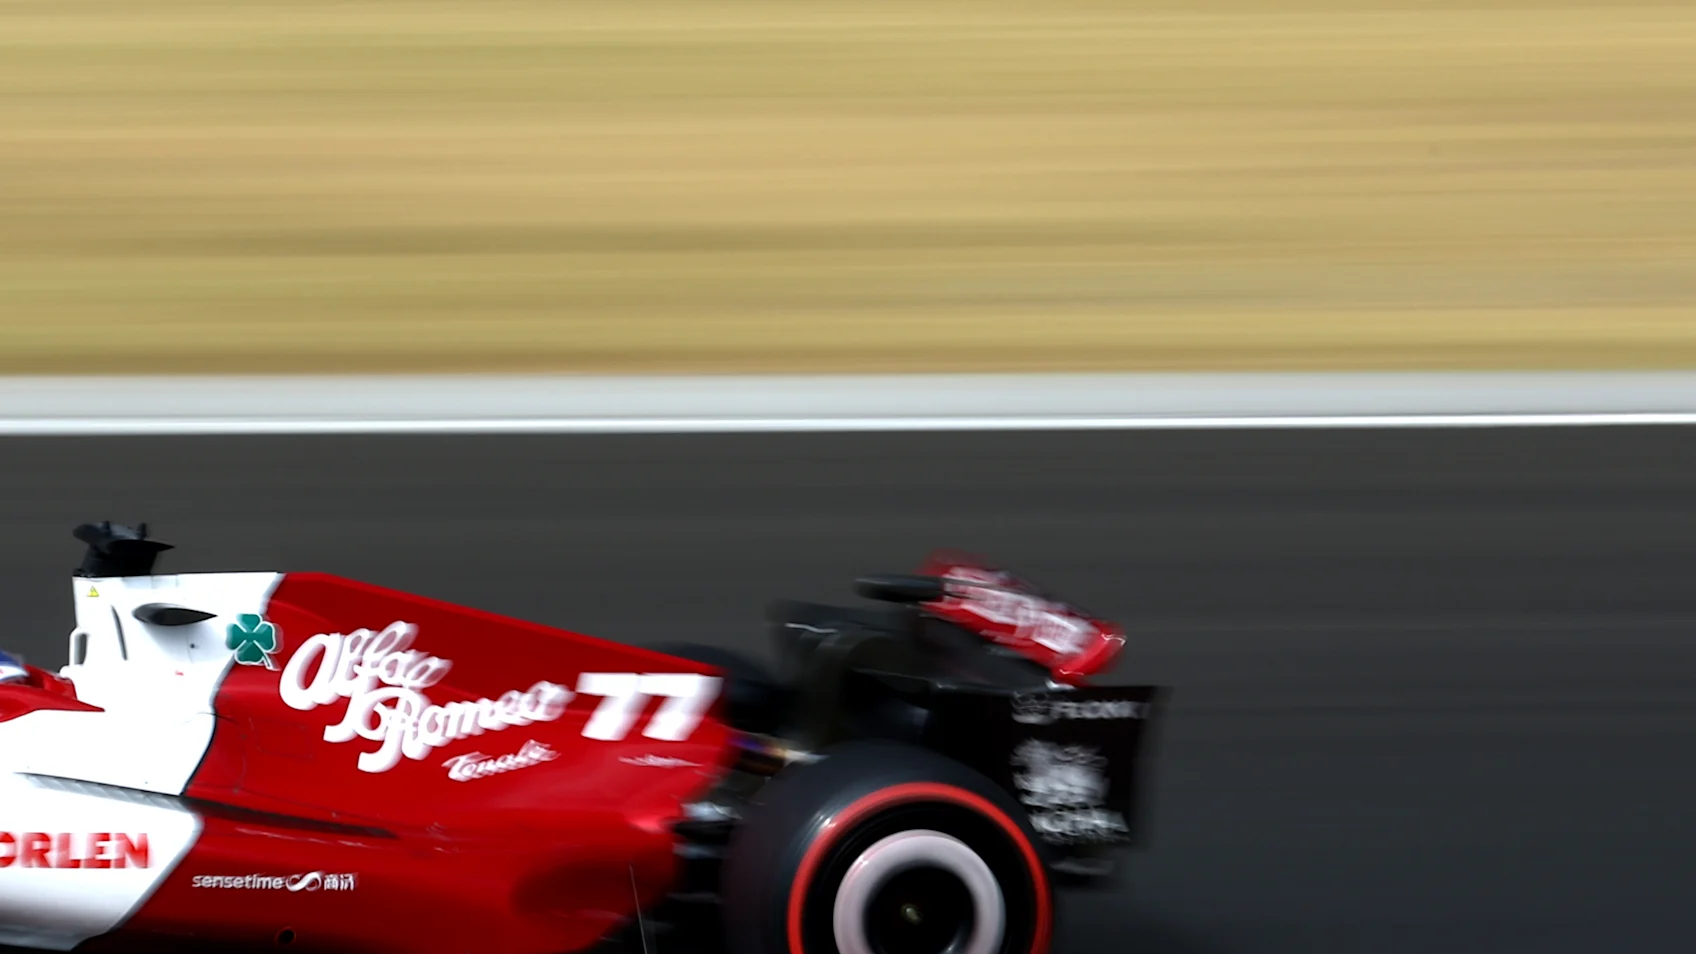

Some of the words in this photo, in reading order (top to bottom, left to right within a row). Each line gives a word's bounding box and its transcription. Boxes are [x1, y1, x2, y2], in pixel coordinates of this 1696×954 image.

[279, 621, 452, 710] Alfa
[323, 680, 577, 773] Romeo
[576, 672, 724, 741] 77
[192, 873, 287, 890] sensetime
